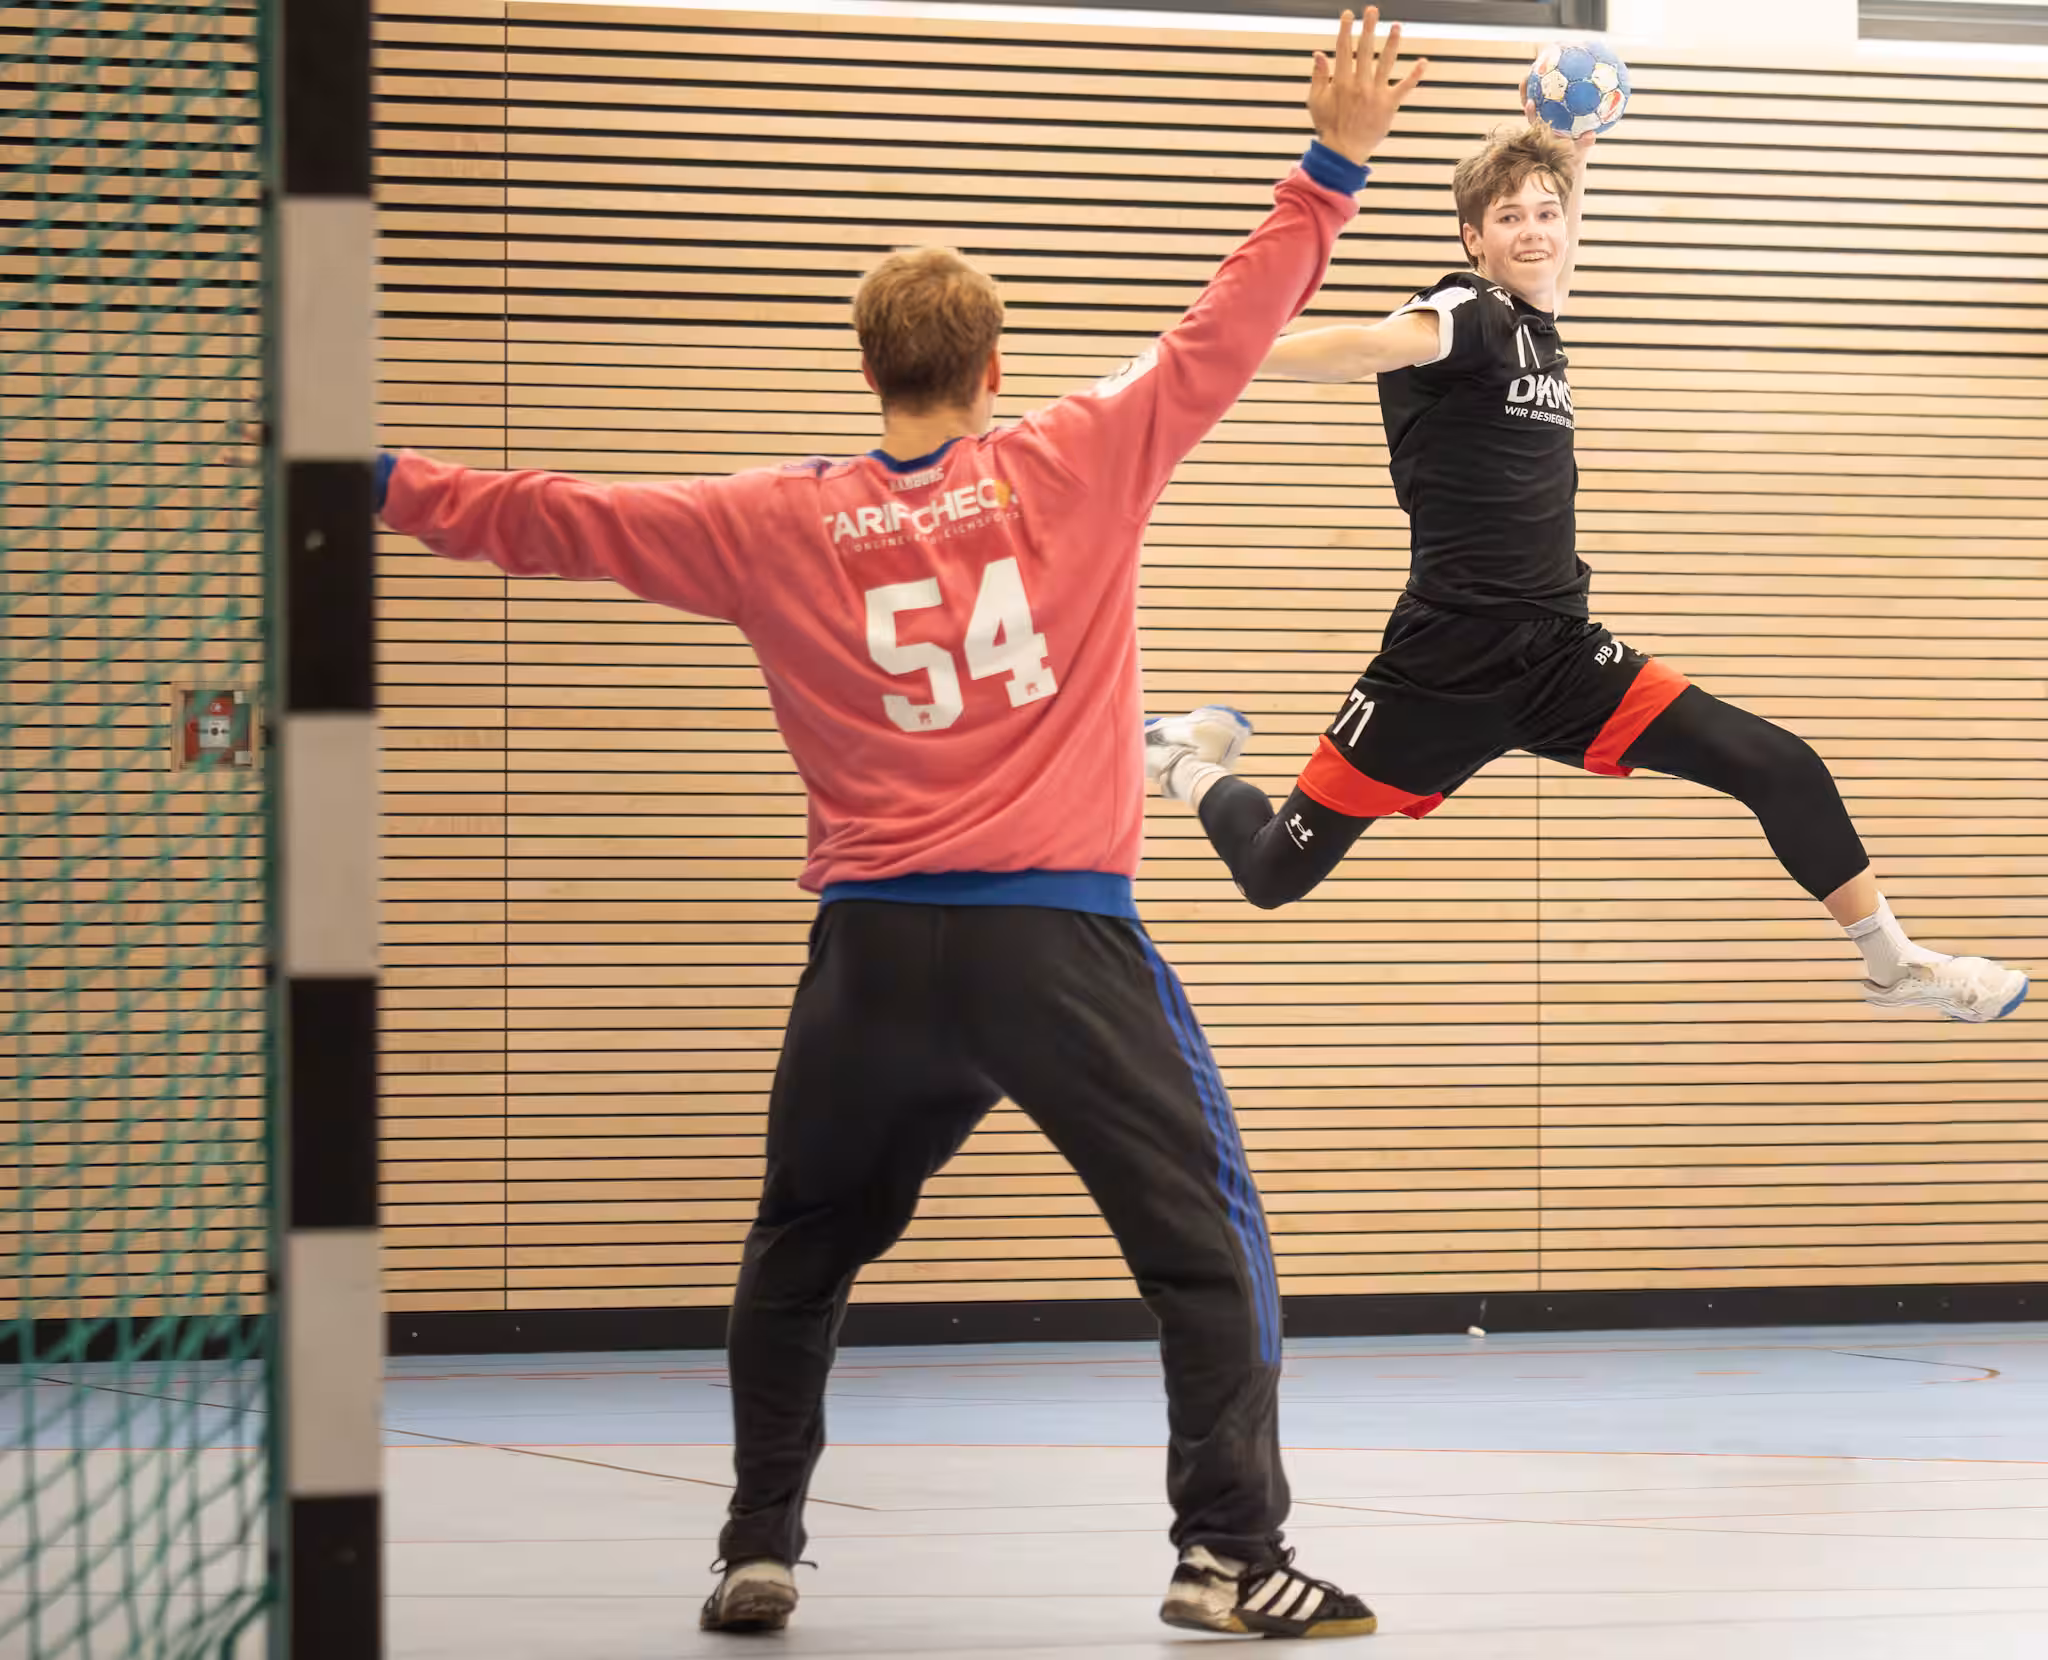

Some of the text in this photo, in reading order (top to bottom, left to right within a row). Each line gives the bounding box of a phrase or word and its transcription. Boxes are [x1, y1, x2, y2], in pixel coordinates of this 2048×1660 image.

[1505, 405, 1528, 417] WIR
[865, 556, 1058, 732] 54
[1332, 688, 1375, 748] 71
